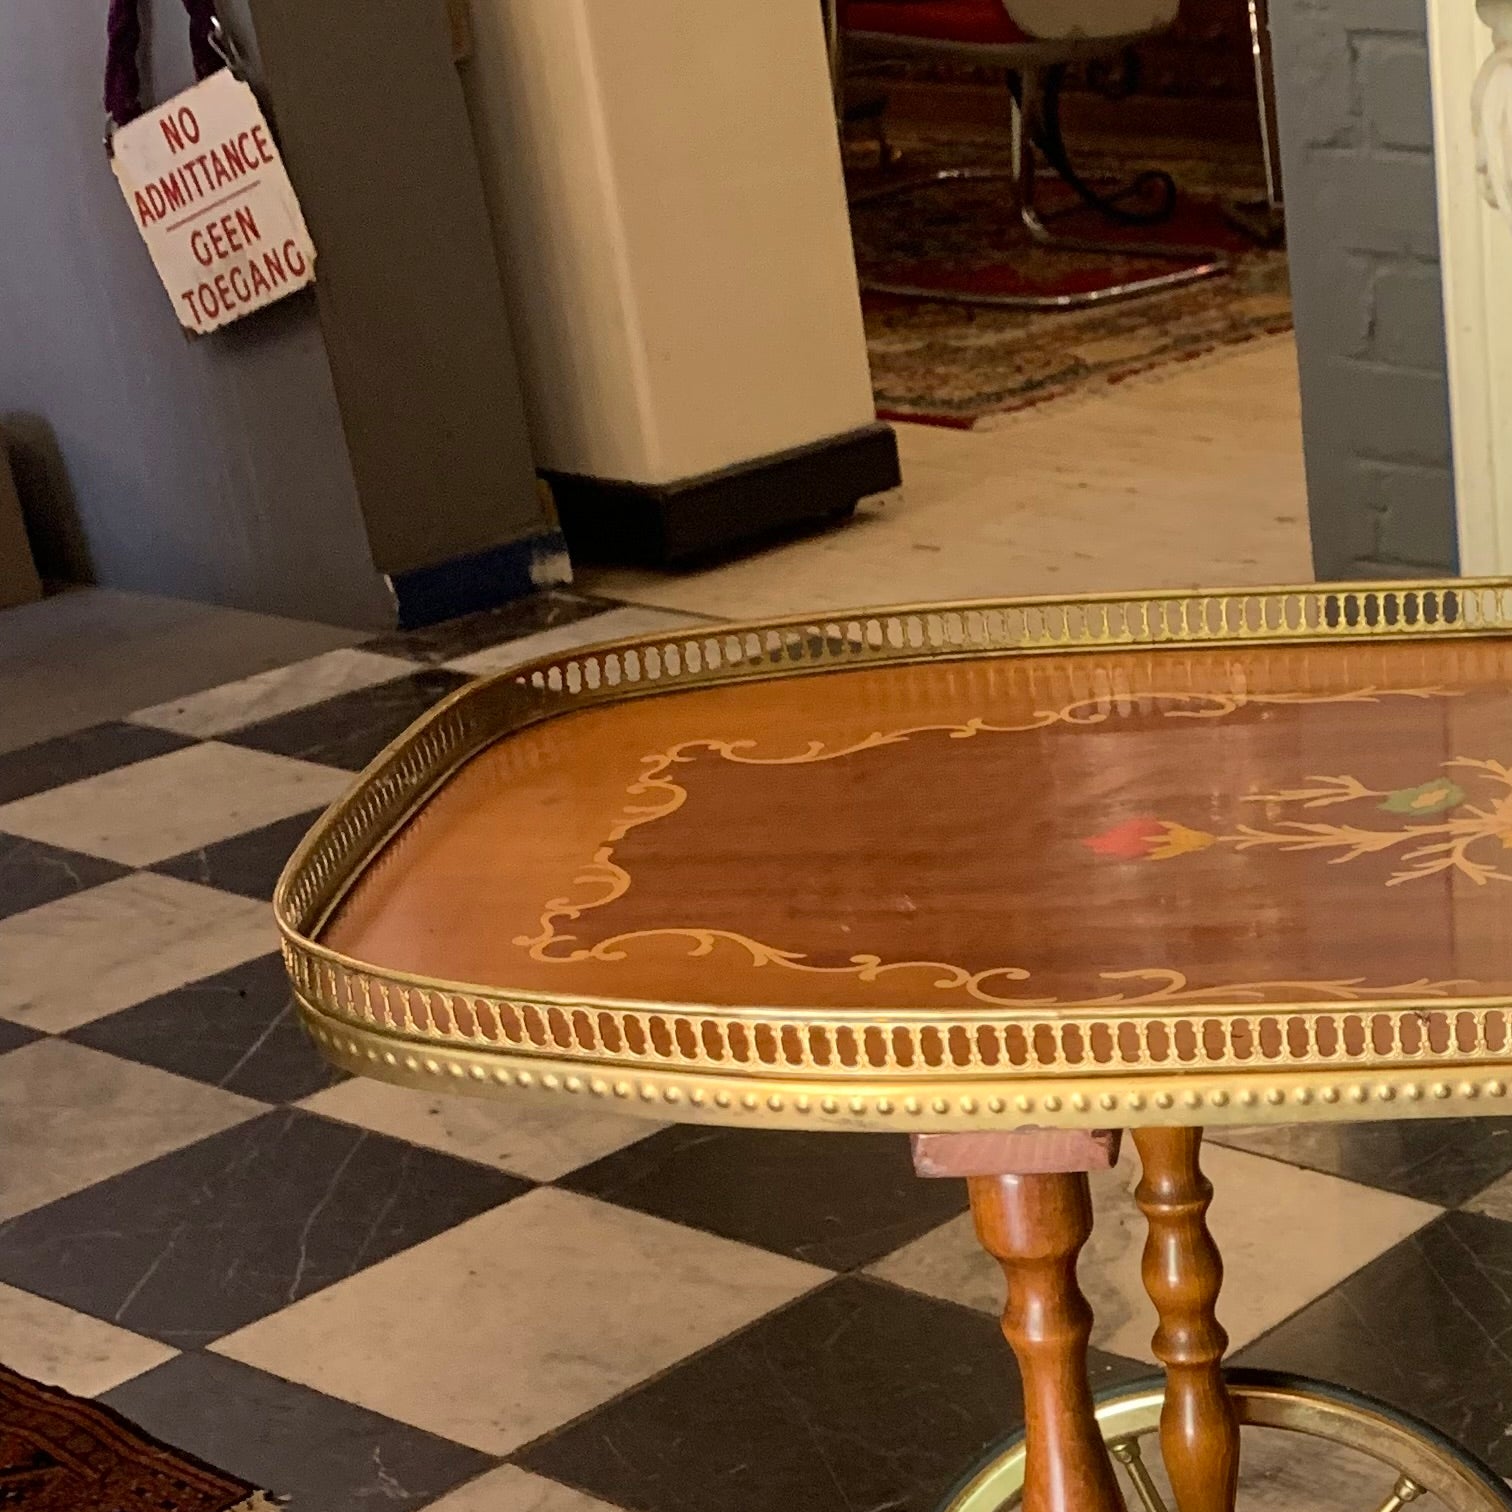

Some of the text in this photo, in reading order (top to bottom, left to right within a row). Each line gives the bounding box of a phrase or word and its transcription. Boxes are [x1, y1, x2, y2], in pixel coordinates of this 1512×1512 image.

[159, 106, 200, 154] NO
[134, 125, 273, 227] ADMITTANCE
[190, 206, 261, 266] GEEN
[181, 239, 306, 324] TOEGANG
